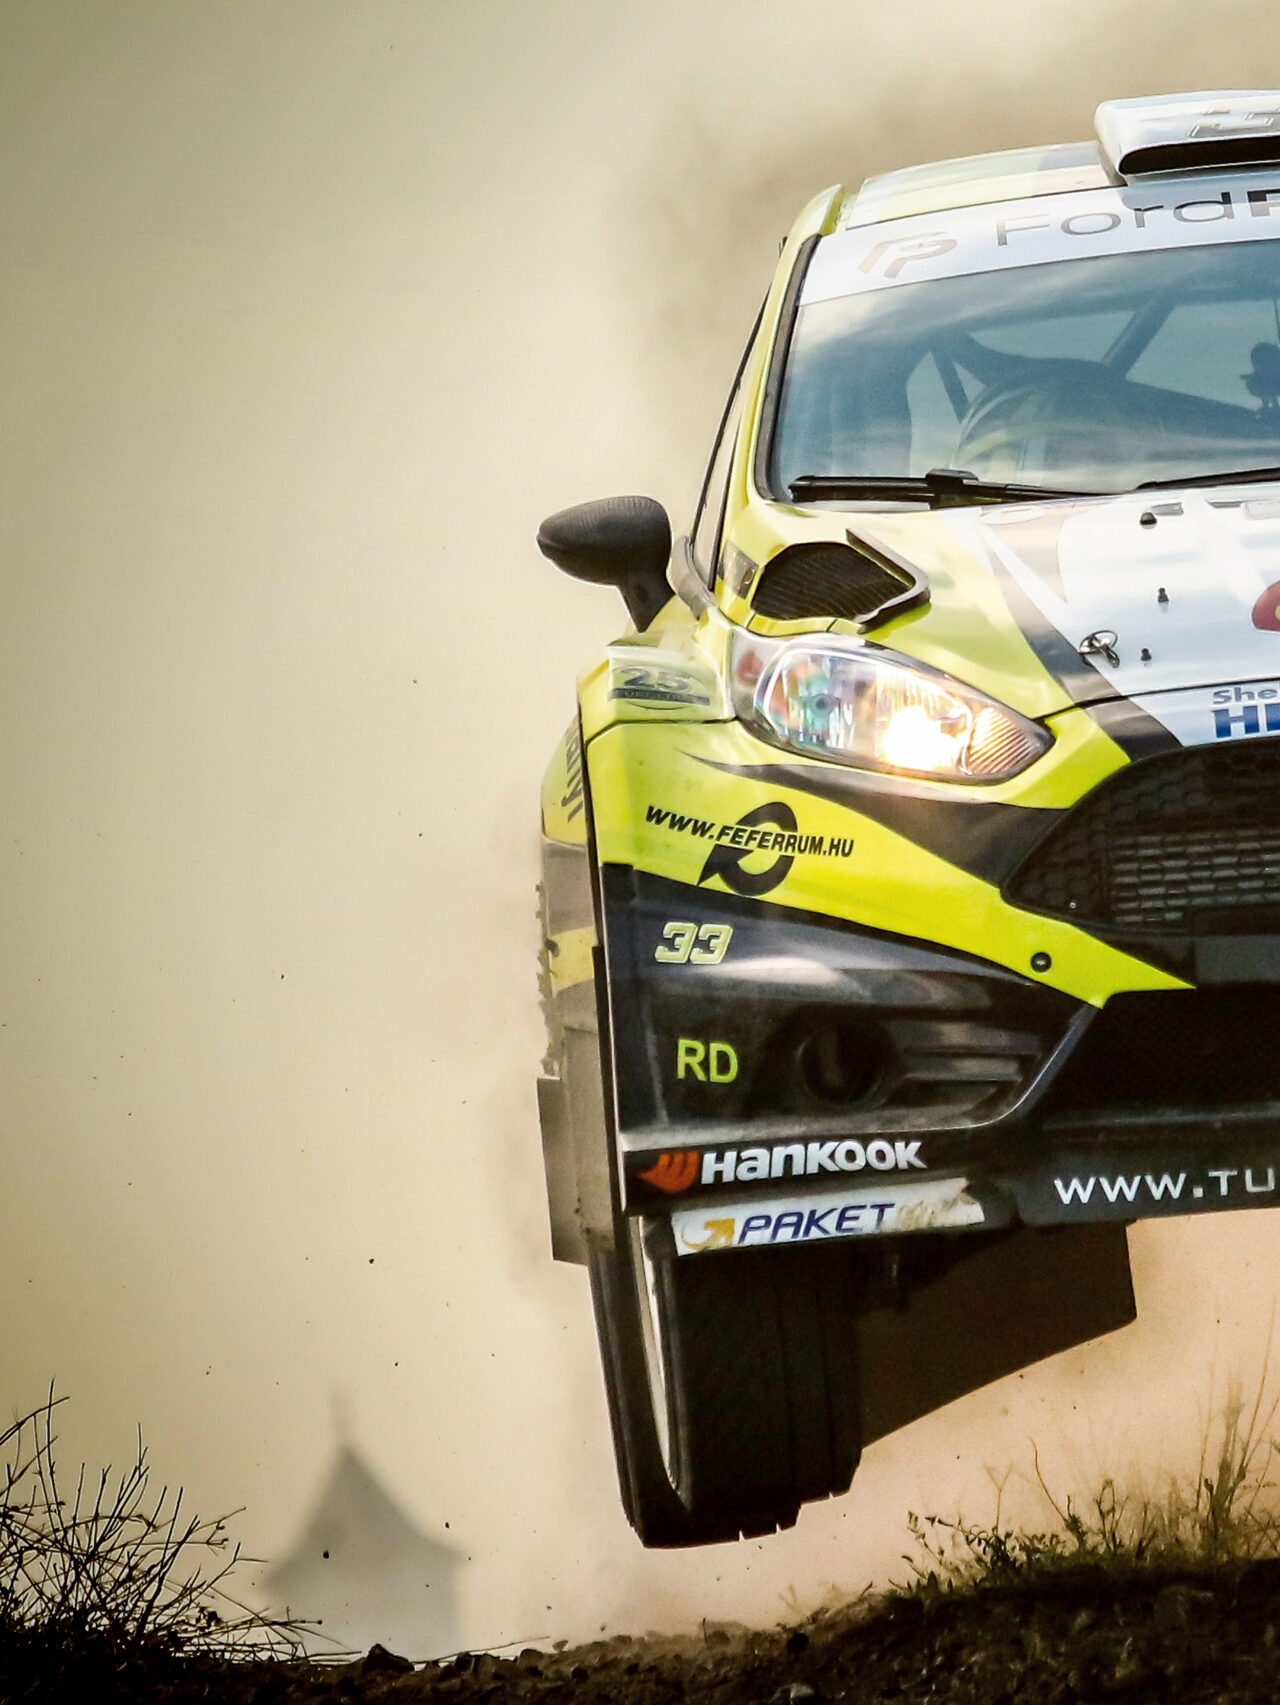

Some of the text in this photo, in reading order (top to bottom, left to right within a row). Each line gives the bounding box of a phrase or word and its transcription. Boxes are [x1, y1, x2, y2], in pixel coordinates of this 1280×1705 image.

[644, 805, 855, 858] WWW.FEFERRUM.HU
[654, 921, 734, 965] 33
[676, 1039, 739, 1084] RD
[738, 1202, 896, 1245] PAKET
